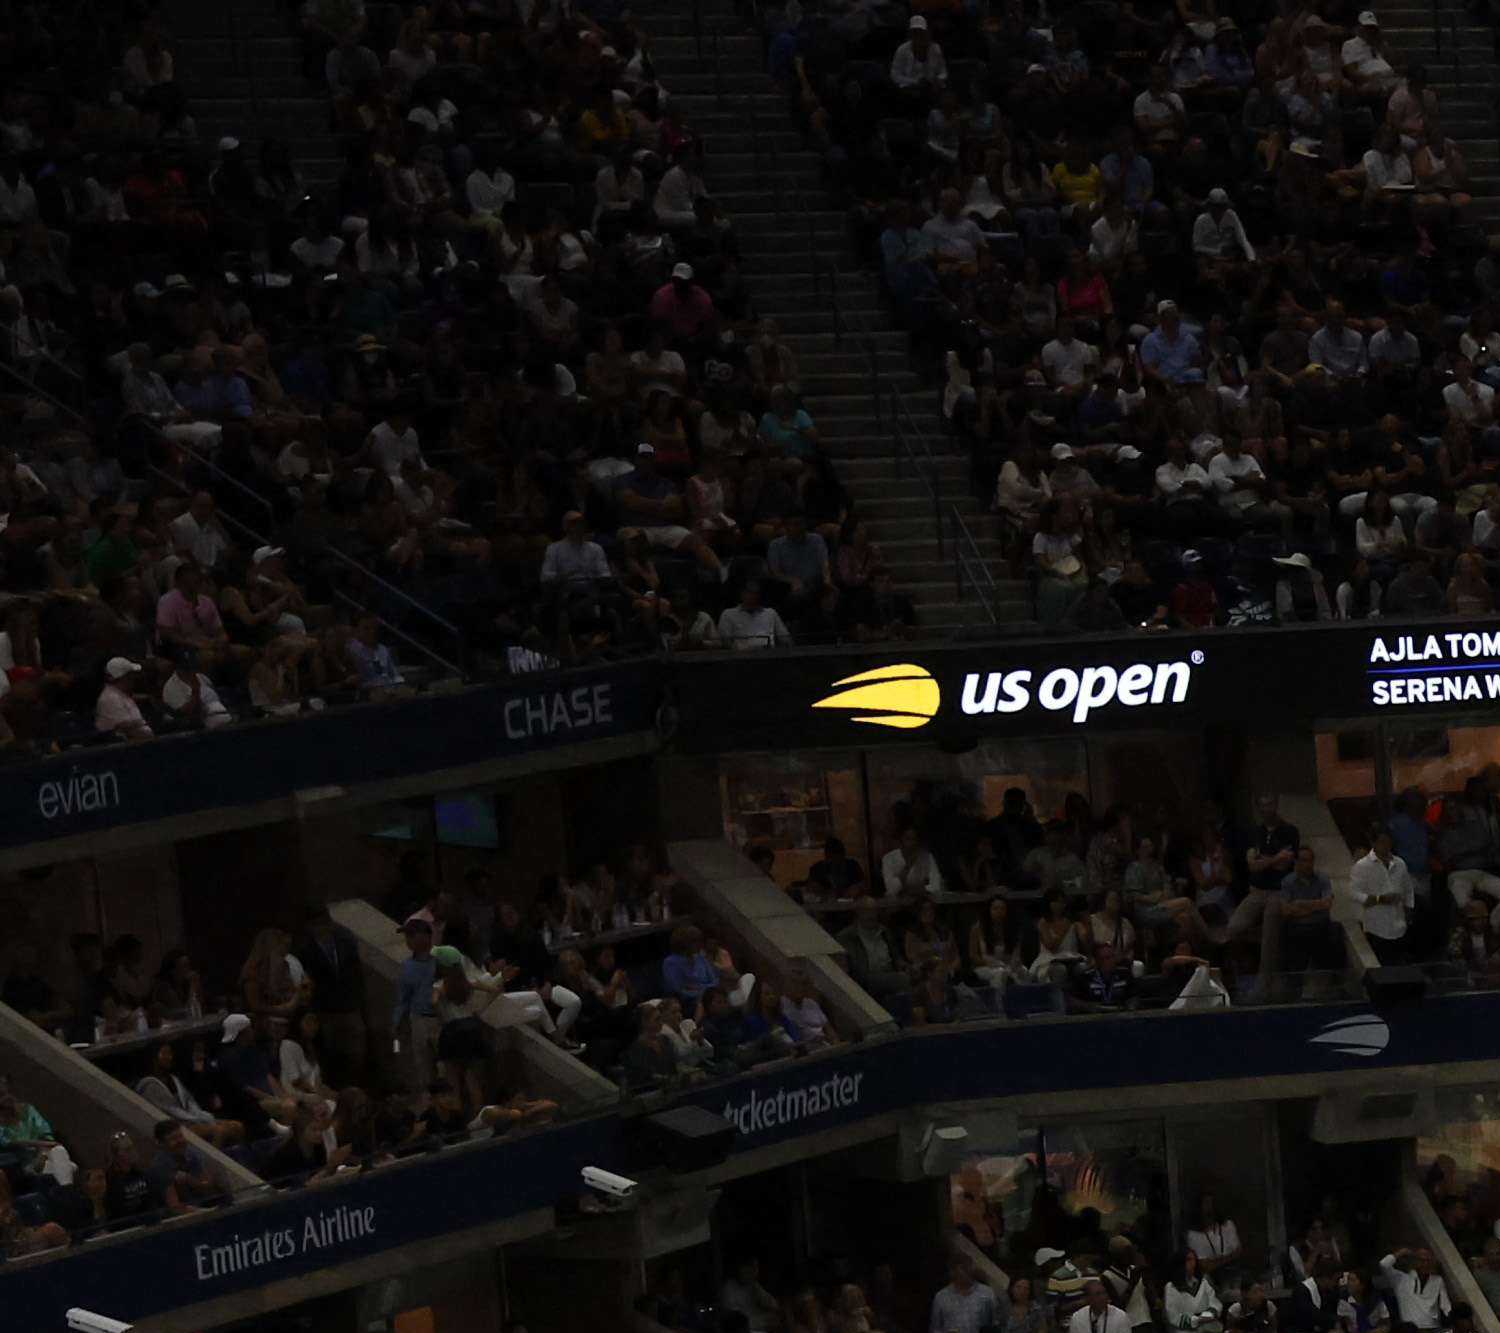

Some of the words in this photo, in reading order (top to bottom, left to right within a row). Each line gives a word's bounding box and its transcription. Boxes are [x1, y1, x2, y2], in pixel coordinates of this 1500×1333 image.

[1371, 637, 1441, 662] AJLA
[504, 684, 611, 738] CHASE
[962, 671, 1031, 714] us
[1039, 662, 1190, 722] open
[1372, 677, 1480, 705] SERENA
[39, 771, 119, 818] evian
[195, 1230, 295, 1279] Emirates
[303, 1206, 375, 1251] Airline
